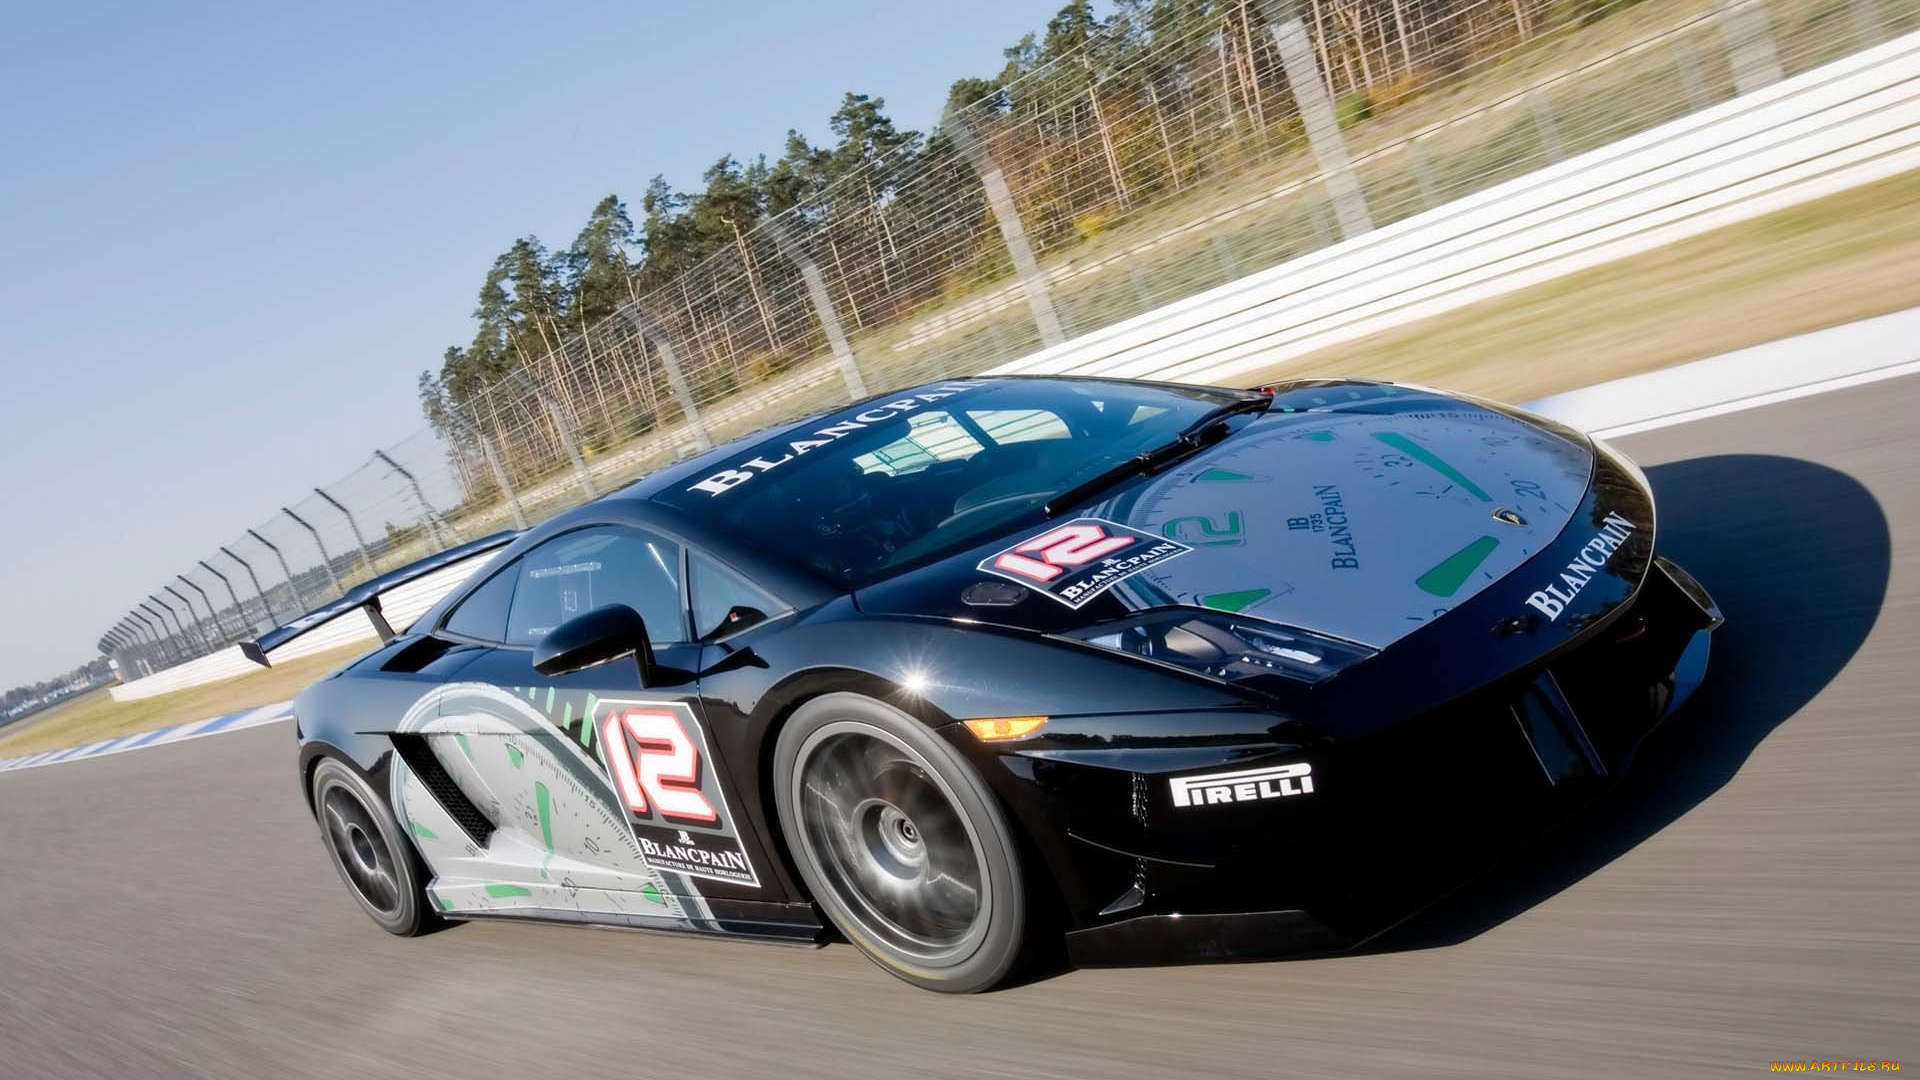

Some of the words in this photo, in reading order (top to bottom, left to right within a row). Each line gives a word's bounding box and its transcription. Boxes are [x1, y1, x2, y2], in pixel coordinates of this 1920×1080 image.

[686, 381, 986, 497] BLANCPAIN
[1310, 512, 1325, 533] 1735
[1312, 484, 1360, 570] BLANCPAIN
[994, 525, 1136, 583] 12
[1059, 542, 1177, 601] BLANCPAIN
[1525, 510, 1637, 622] BLANCPAIN
[602, 708, 717, 822] 12
[1169, 762, 1314, 807] PIRELLI
[638, 836, 747, 871] BLANCPAIN
